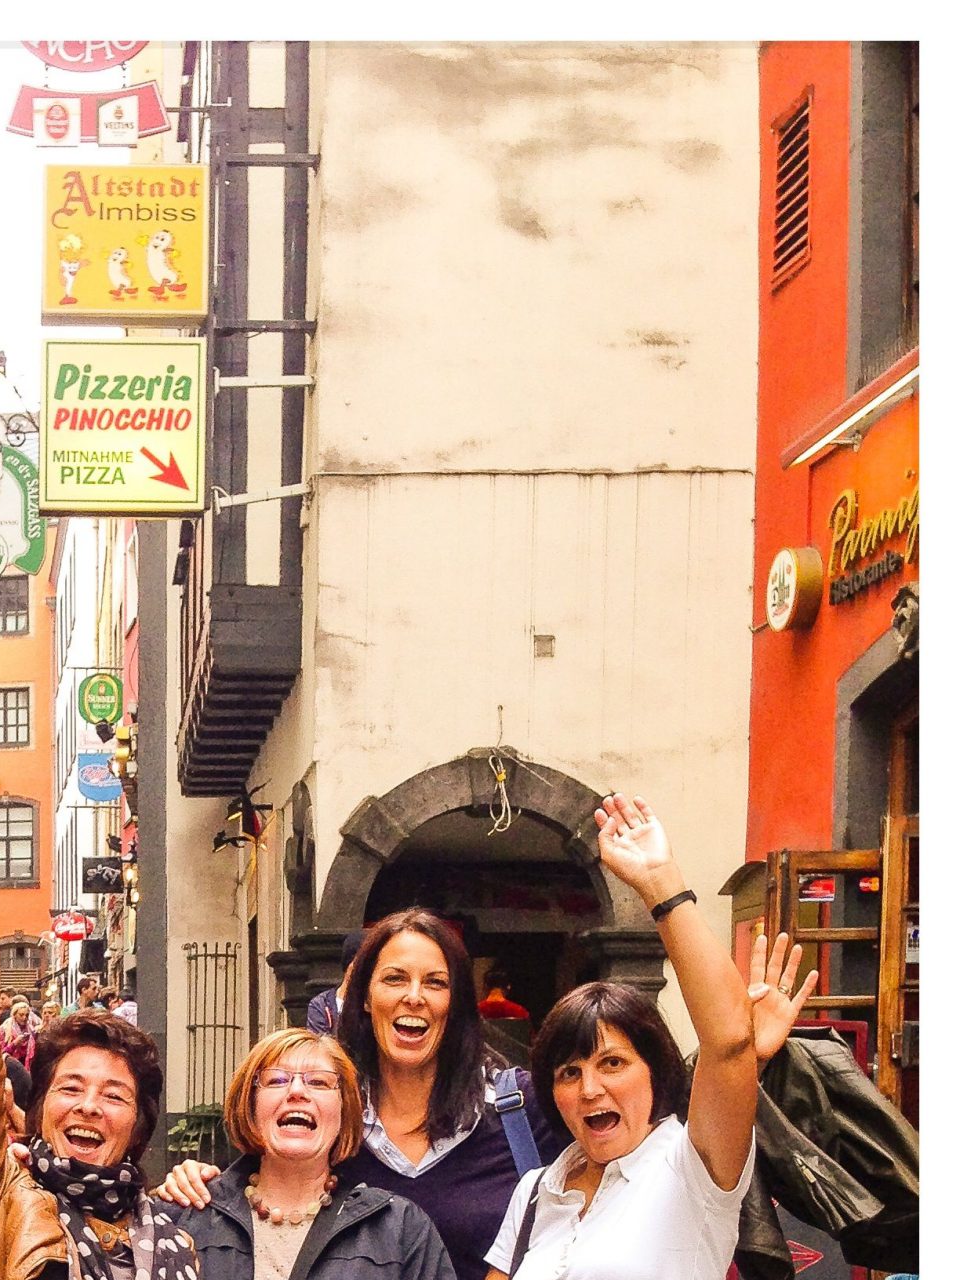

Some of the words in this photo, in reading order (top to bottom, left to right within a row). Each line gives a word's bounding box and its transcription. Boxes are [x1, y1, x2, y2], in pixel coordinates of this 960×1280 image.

[51, 171, 201, 229] Altstadt
[99, 202, 197, 222] Imbiss
[53, 363, 193, 401] Pizzeria
[53, 408, 193, 431] PINOCCHIO
[52, 450, 133, 463] MITNAHME
[60, 466, 126, 485] PIZZA
